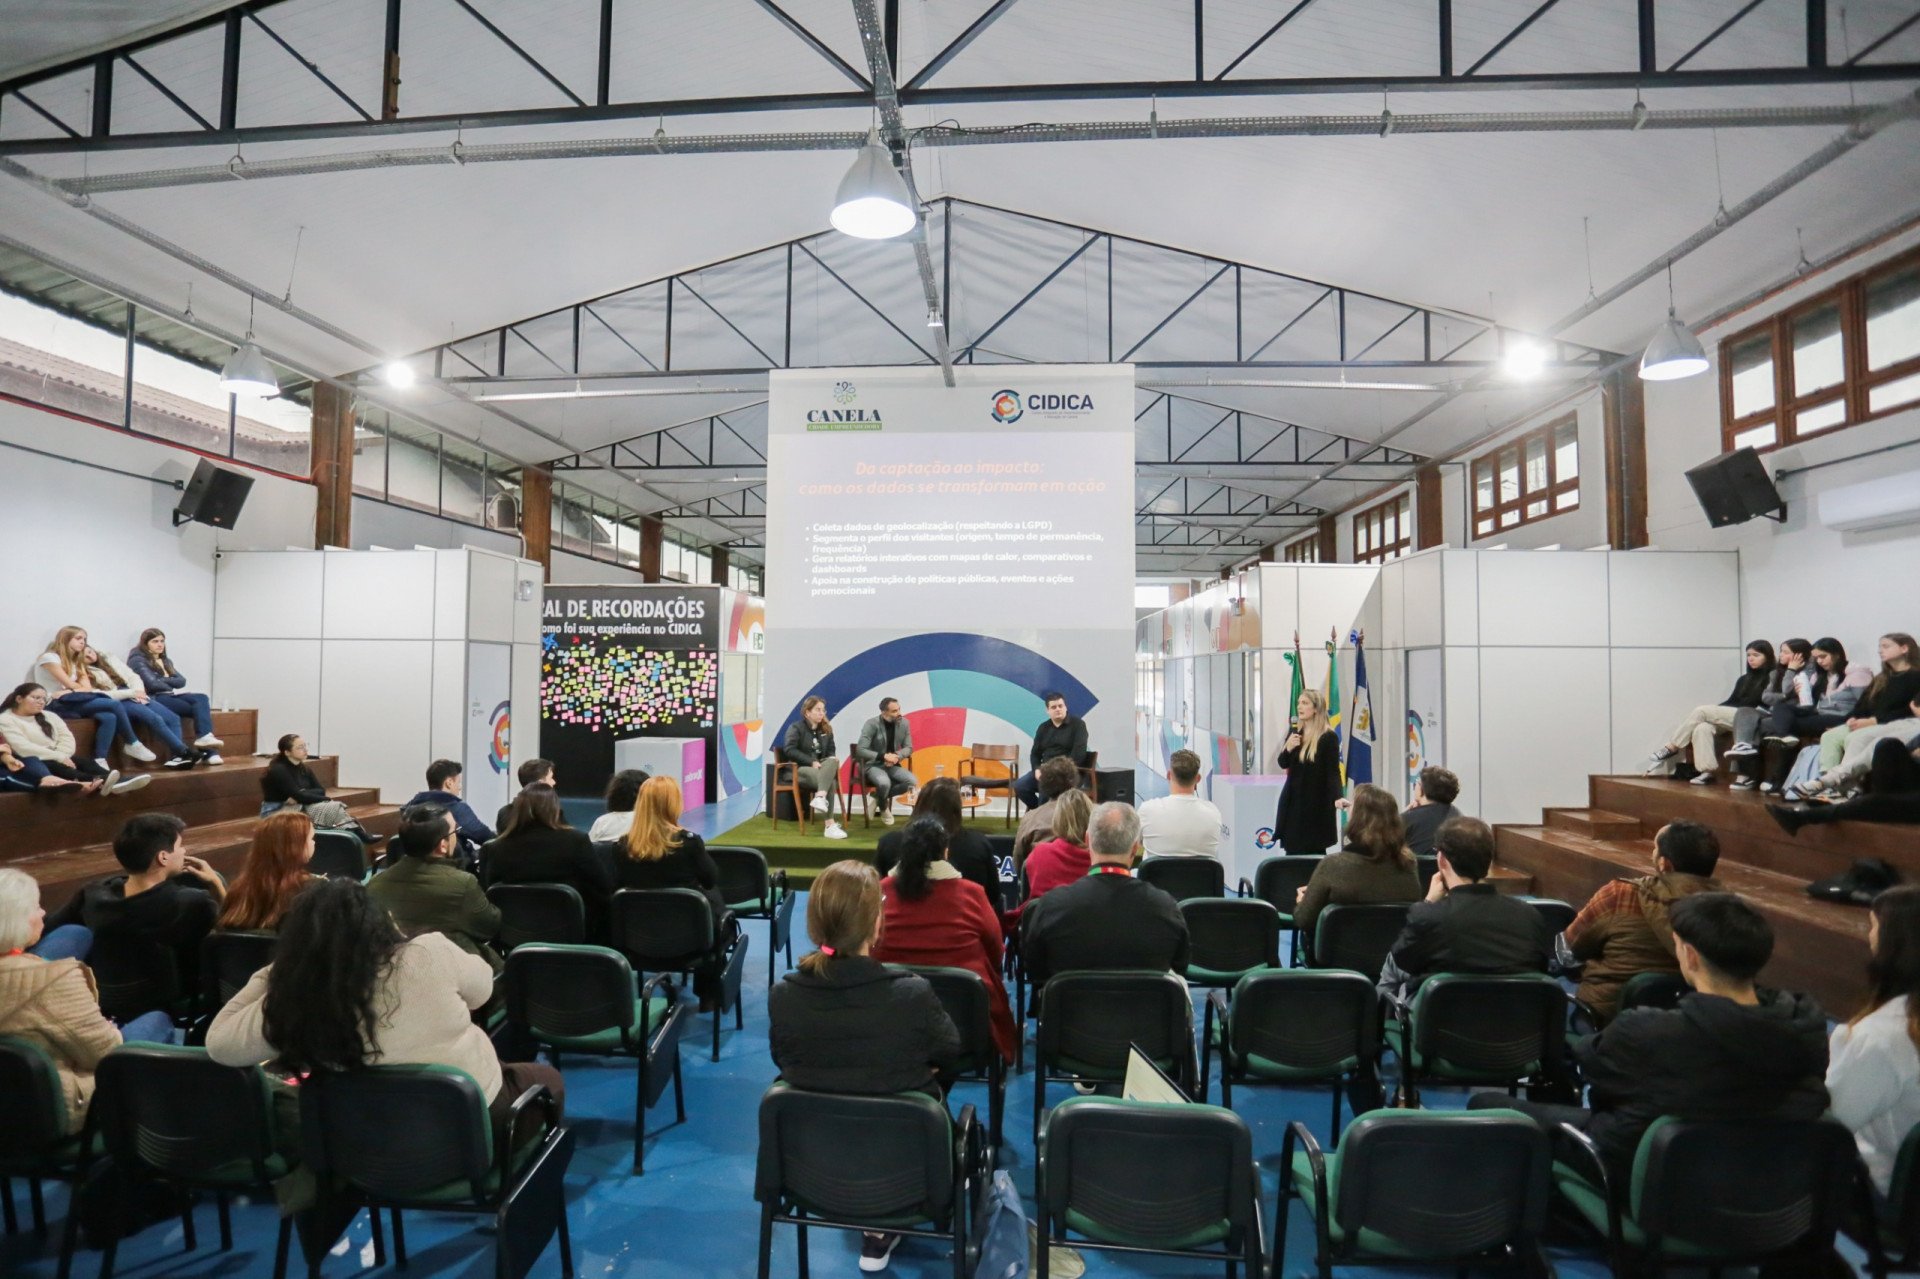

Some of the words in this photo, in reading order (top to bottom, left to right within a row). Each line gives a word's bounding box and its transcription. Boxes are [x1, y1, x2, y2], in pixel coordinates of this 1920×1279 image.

[1028, 394, 1094, 410] CIDICA
[807, 409, 882, 422] CANELA
[879, 460, 951, 477] captação
[953, 463, 973, 474] ao
[976, 460, 1045, 476] impacto:
[799, 484, 843, 495] como
[845, 484, 864, 495] os
[866, 481, 914, 494] dados
[917, 483, 935, 493] se
[937, 480, 1039, 495] transformam
[1039, 482, 1064, 492] em
[1067, 477, 1106, 495] ação
[812, 523, 843, 532] Coleta
[844, 522, 872, 531] dados
[873, 522, 886, 531] de
[886, 521, 953, 532] geolocalização
[955, 521, 1014, 532] (respeitando
[1022, 520, 1053, 531] LGPD)
[812, 534, 859, 544] Segmenta
[867, 533, 891, 543] perfil
[893, 533, 910, 542] dos
[911, 532, 954, 542] visitantes
[955, 532, 994, 543] (origem,
[995, 533, 1025, 543] tempo
[1026, 532, 1038, 541] de
[1039, 531, 1104, 543] permanência,
[812, 543, 867, 555] frequência)
[812, 554, 834, 563] Gera
[835, 554, 878, 563] relatórios
[879, 553, 927, 562] interativos
[928, 554, 949, 562] com
[950, 554, 980, 563] mapas
[981, 552, 994, 561] de
[995, 552, 1021, 562] calor,
[1022, 552, 1085, 563] comparativos
[811, 564, 868, 574] dashboards
[811, 576, 838, 586] Apoia
[839, 577, 851, 585] na
[852, 575, 904, 585] construção
[904, 574, 917, 583] de
[917, 574, 957, 585] políticas
[958, 573, 999, 585] públicas,
[1000, 575, 1037, 583] eventos
[1046, 573, 1075, 585] ações
[811, 586, 876, 597] promocionais
[542, 600, 563, 618] AL
[567, 599, 587, 618] DE
[592, 596, 705, 623] RECORDAÇÕES
[563, 622, 577, 634] foi
[579, 625, 597, 634] sua
[597, 623, 651, 635] experiência
[653, 625, 666, 635] no
[668, 623, 702, 635] CIDICA
